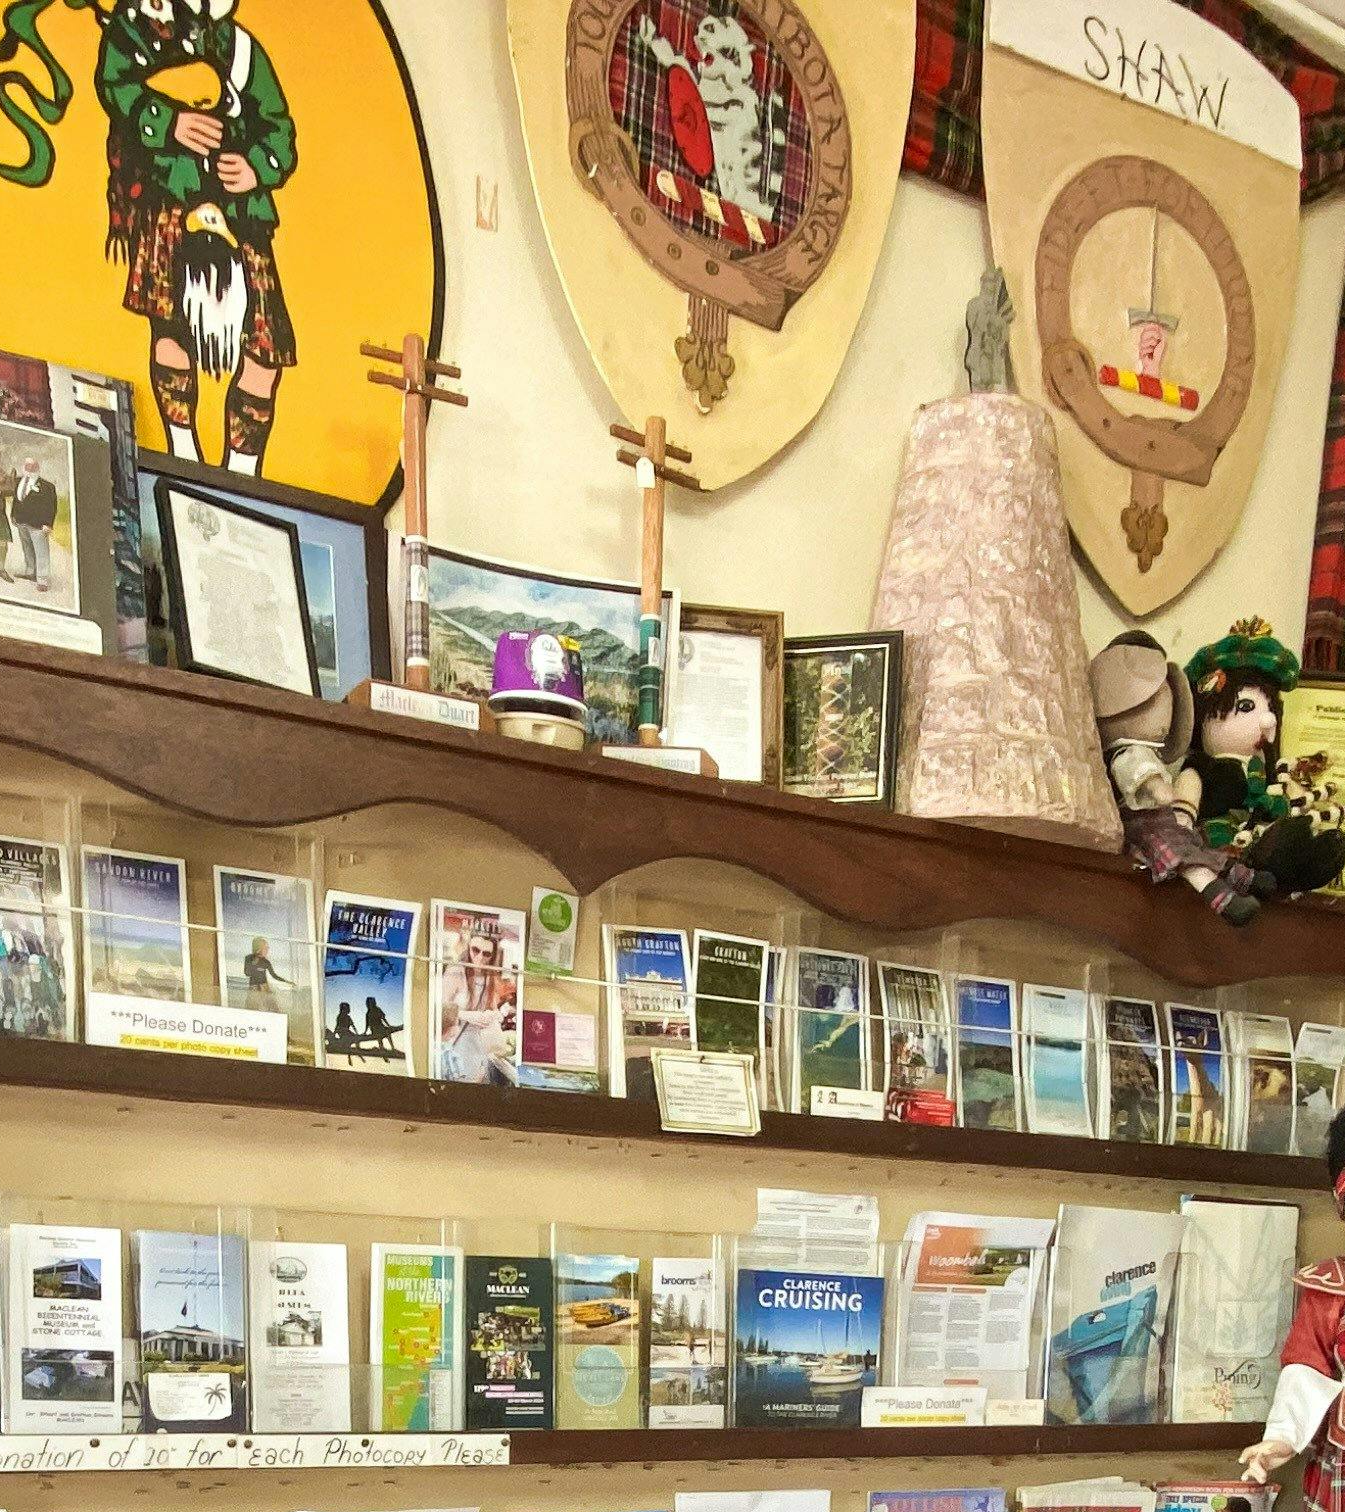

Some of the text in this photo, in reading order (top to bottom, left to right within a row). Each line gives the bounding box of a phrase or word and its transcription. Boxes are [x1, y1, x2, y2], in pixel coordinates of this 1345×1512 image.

[1084, 17, 1231, 131] SHAW
[661, 1274, 697, 1286] brooms
[1105, 1261, 1156, 1288] clarence
[387, 1278, 453, 1291] NORTHERN
[486, 1284, 530, 1294] MACLEAN
[783, 1279, 841, 1293] CLARENCE
[758, 1289, 863, 1313] CRUISING
[108, 1437, 139, 1468] of
[186, 1438, 223, 1467] for
